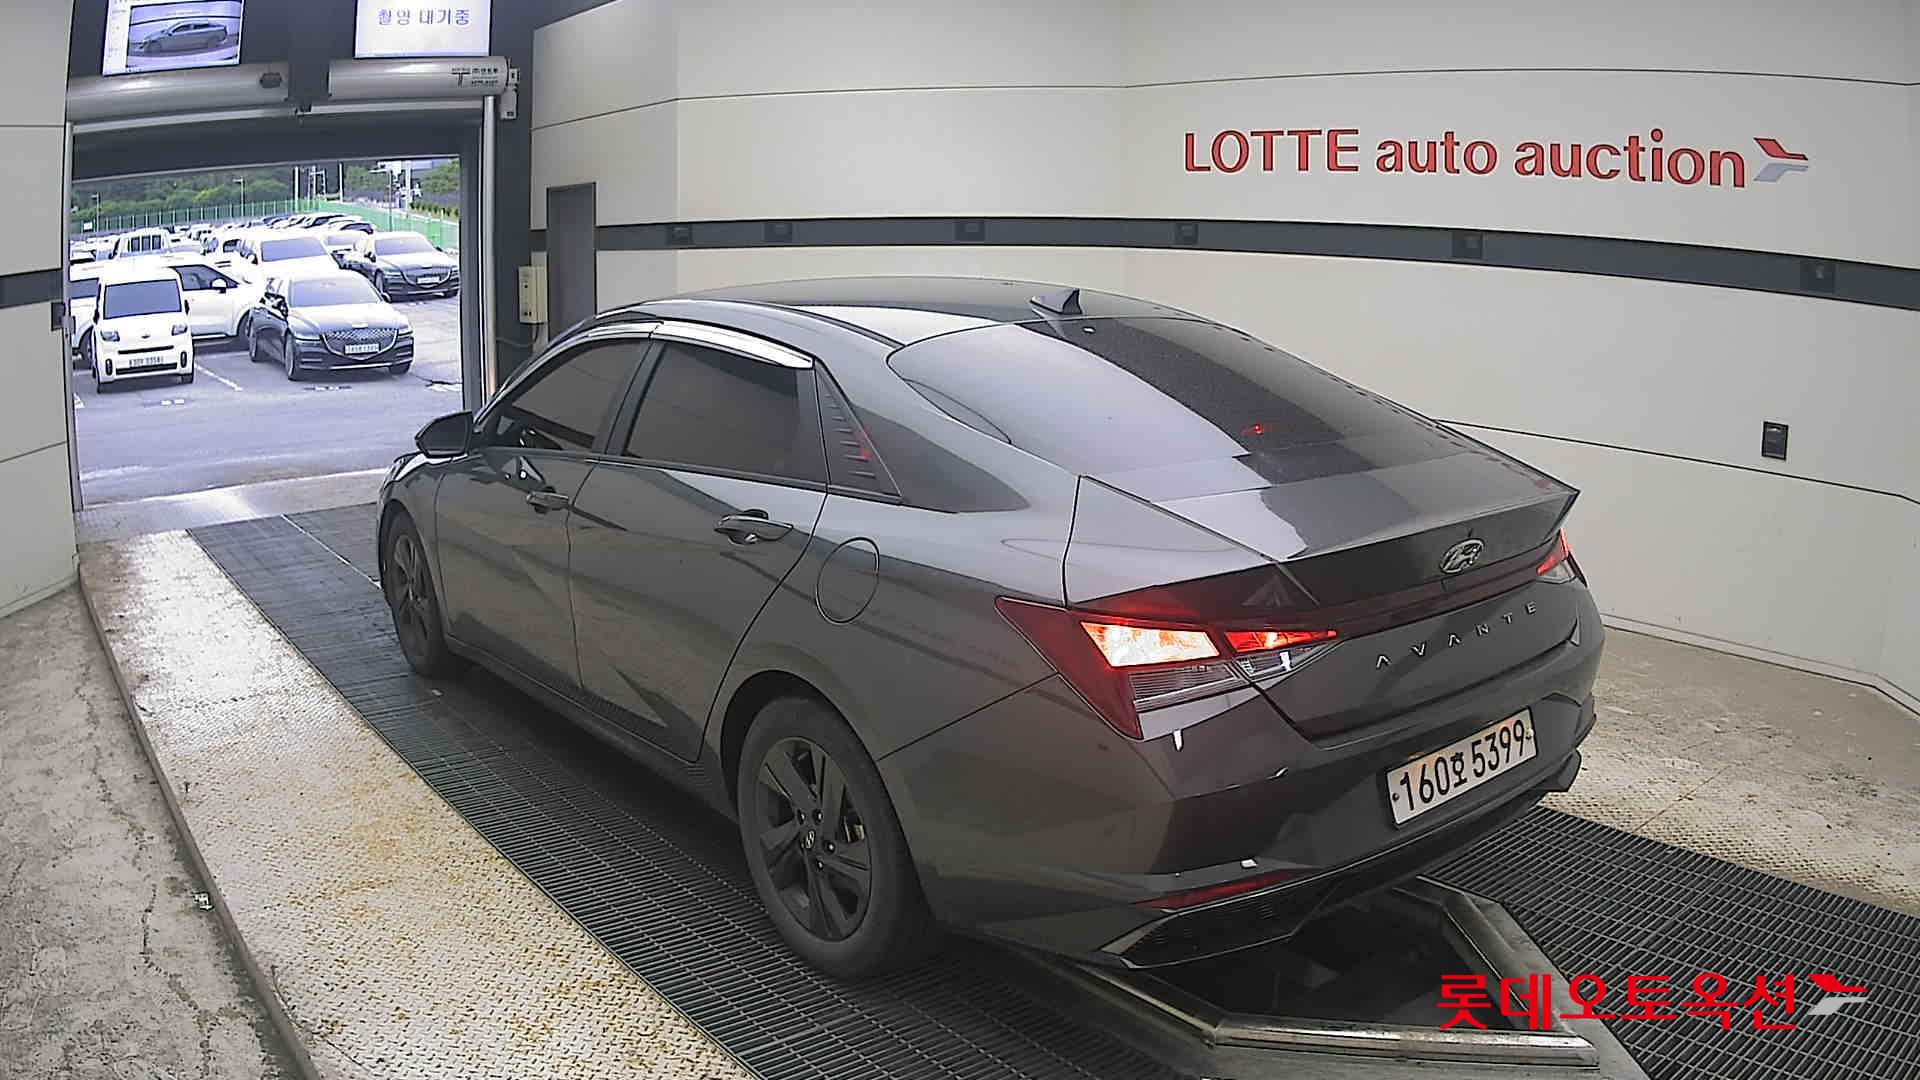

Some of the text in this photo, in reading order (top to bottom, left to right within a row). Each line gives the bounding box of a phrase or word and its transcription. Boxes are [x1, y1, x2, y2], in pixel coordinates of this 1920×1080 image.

[419, 8, 470, 26] 대기중
[1185, 128, 1745, 188] LOTTE auto auction
[1375, 600, 1538, 669] AVANTE
